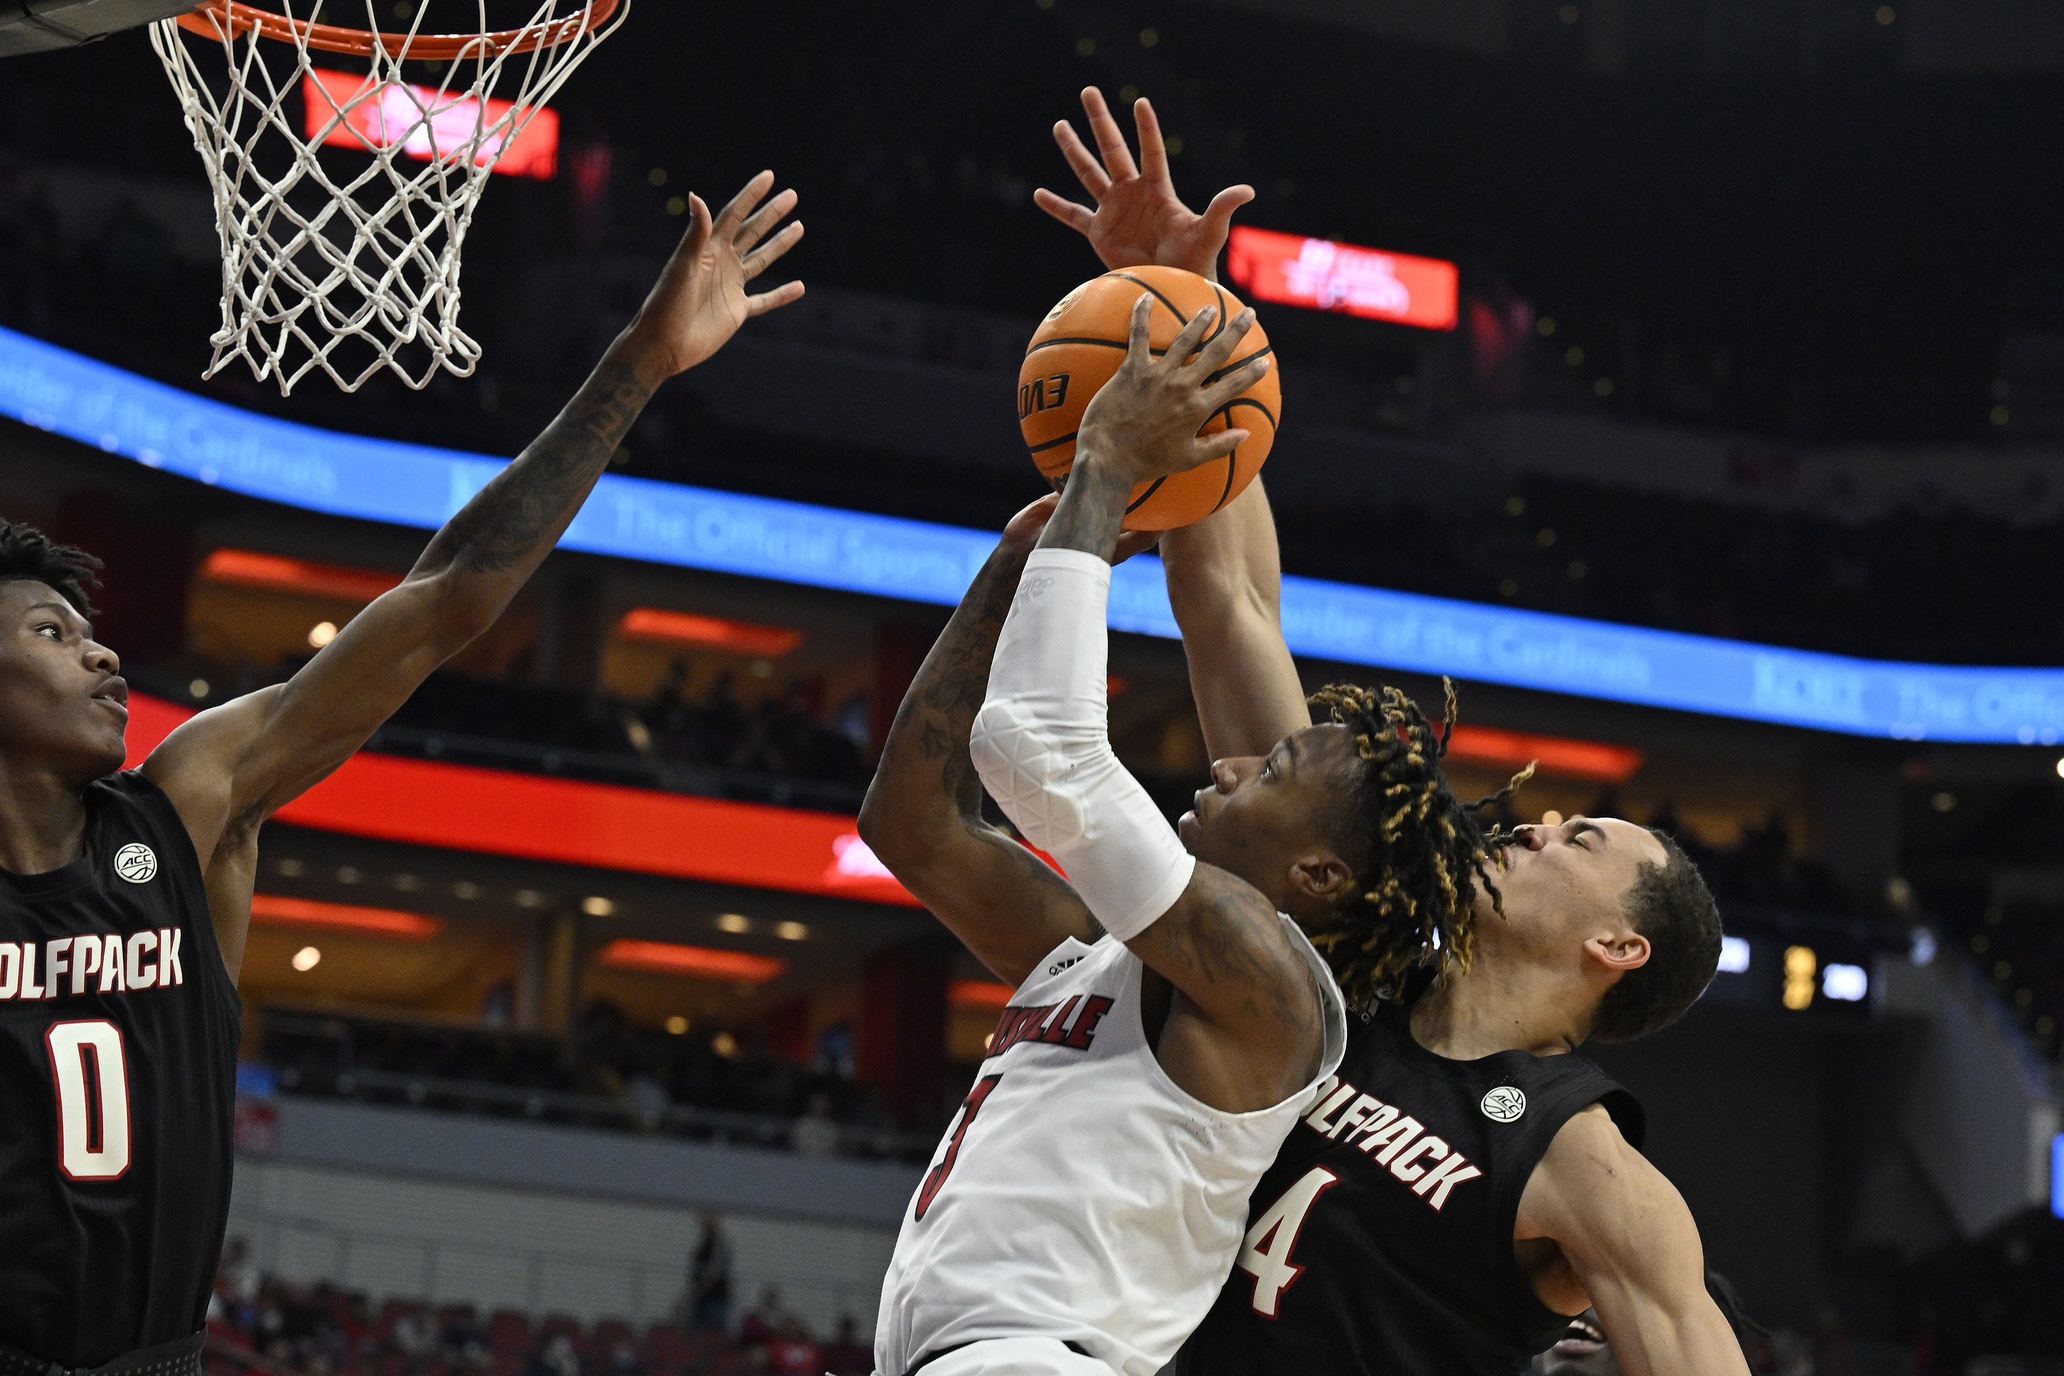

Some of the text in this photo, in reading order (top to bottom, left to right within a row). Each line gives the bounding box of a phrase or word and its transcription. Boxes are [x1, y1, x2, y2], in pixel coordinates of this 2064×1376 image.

[122, 852, 153, 867] ACC
[44, 1018, 131, 1182] 0
[1494, 1094, 1521, 1114] ACC
[1236, 1163, 1342, 1320] 4
